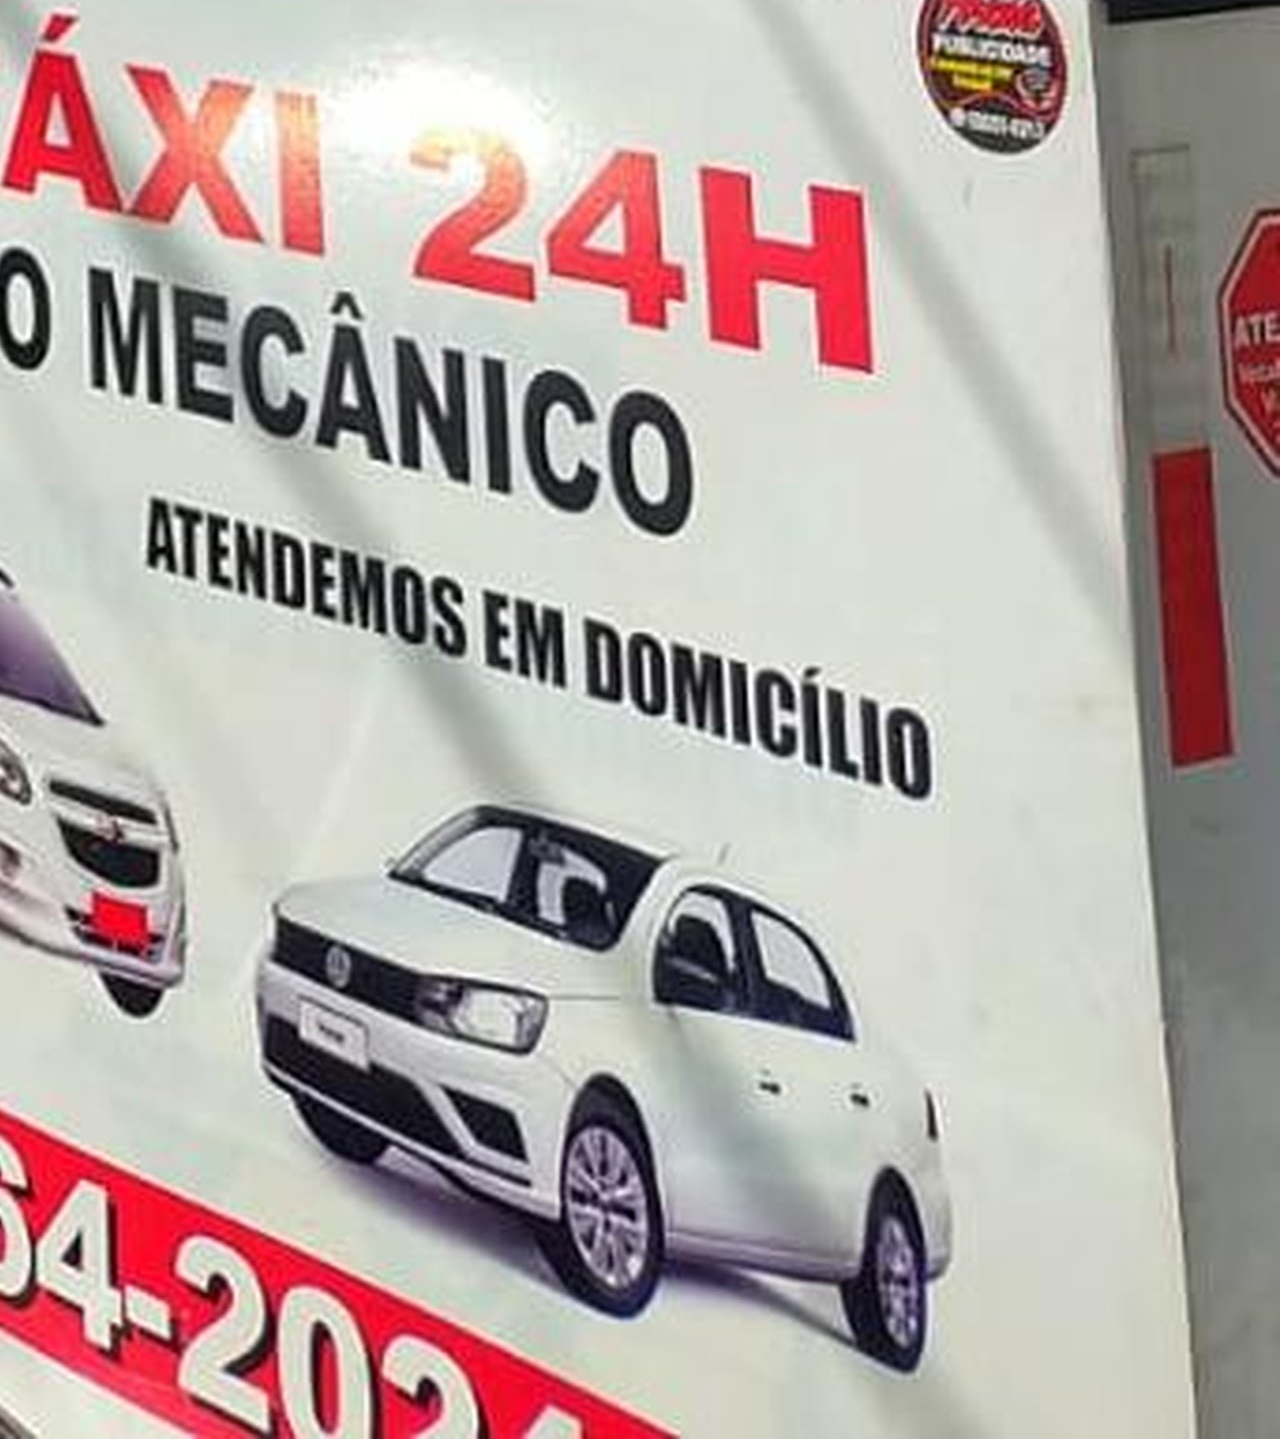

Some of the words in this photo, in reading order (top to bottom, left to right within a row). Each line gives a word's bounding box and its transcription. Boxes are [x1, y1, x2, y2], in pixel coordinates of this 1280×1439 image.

[409, 123, 876, 375] 24H
[89, 268, 695, 538] MECÂNICO
[146, 499, 468, 659] ATENDEMOS
[482, 590, 568, 688] EM
[584, 620, 934, 801] DOMICÍLIO
